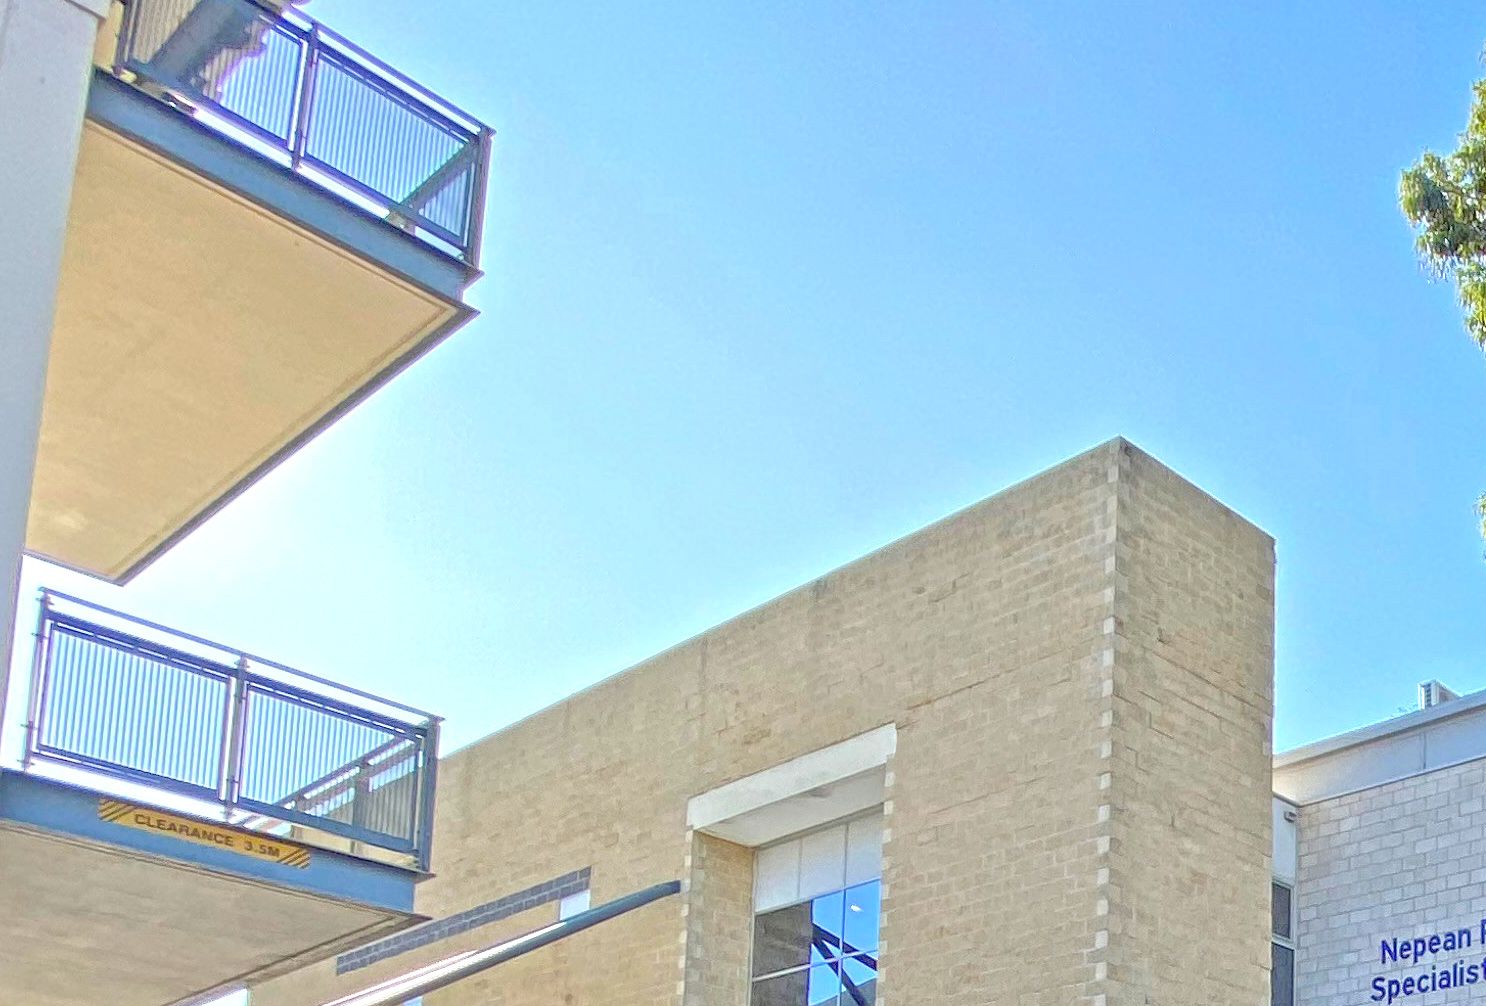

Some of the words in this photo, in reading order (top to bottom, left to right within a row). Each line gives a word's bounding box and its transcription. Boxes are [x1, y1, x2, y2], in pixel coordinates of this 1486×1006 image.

[134, 813, 235, 846] CLEARANCE
[244, 840, 281, 858] 3.5M
[1380, 927, 1473, 966] Nepean
